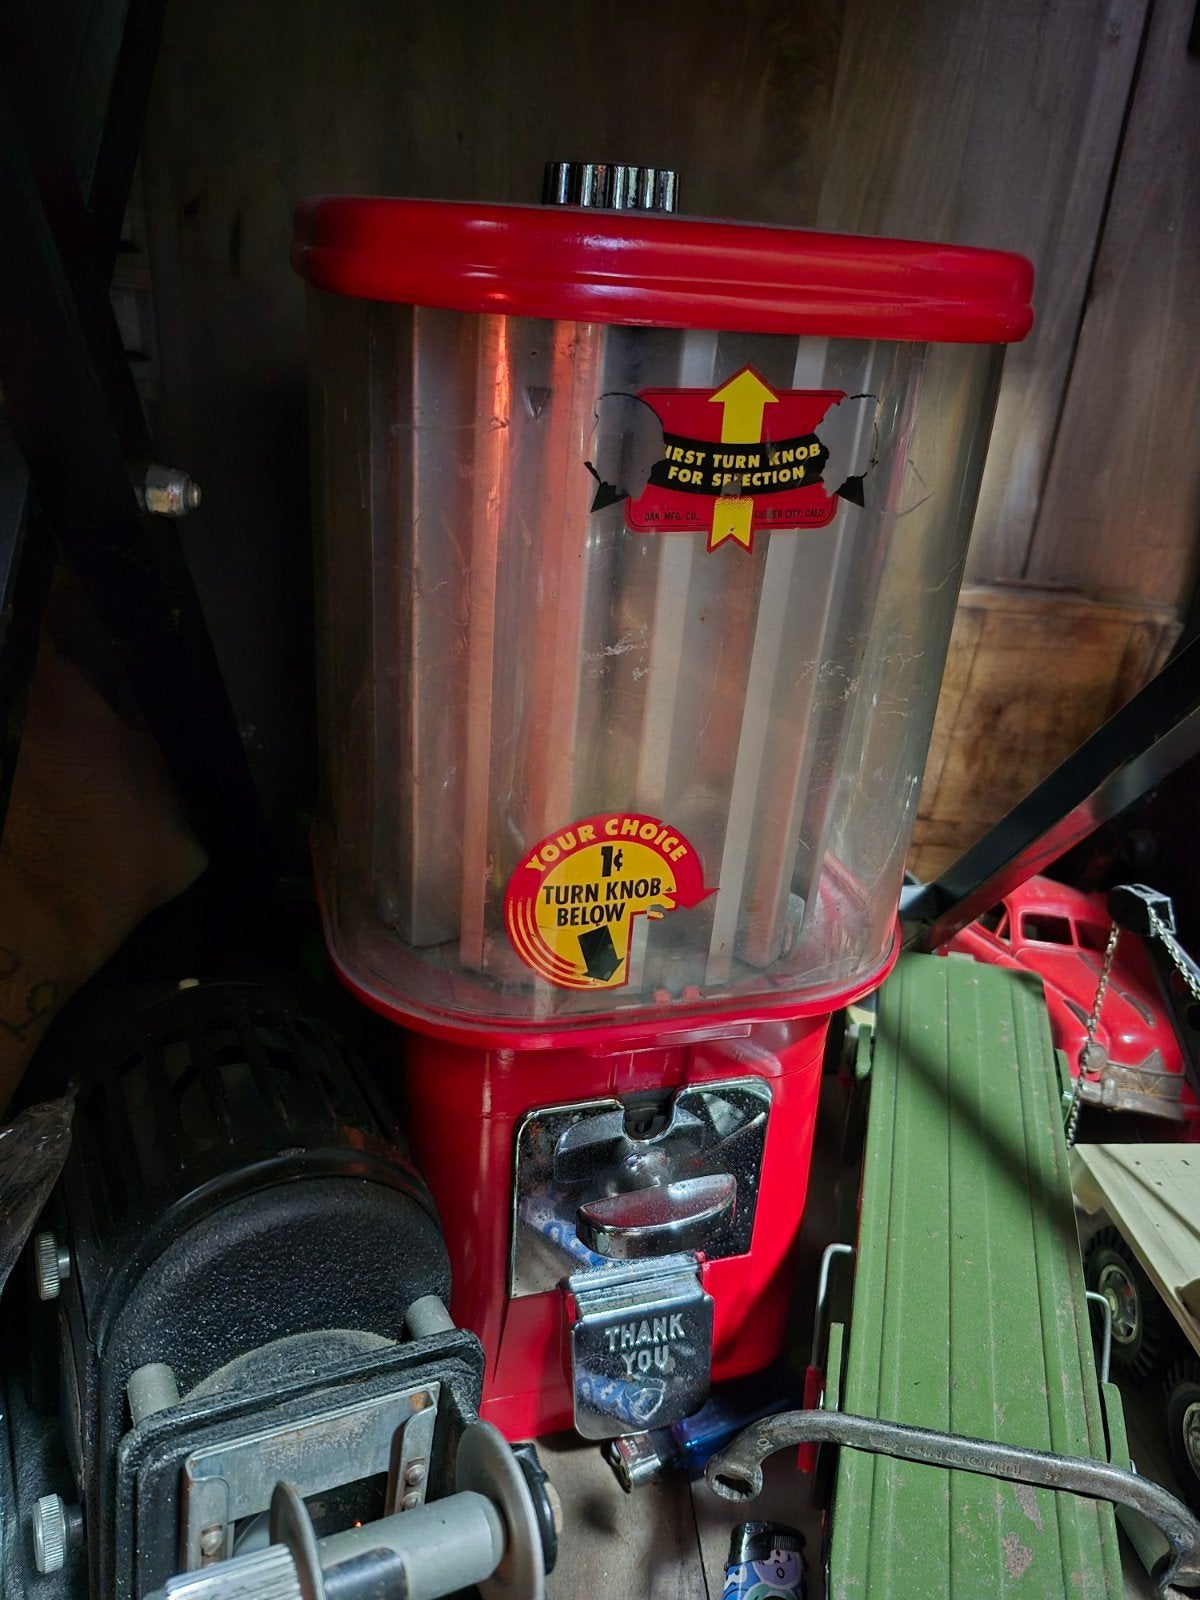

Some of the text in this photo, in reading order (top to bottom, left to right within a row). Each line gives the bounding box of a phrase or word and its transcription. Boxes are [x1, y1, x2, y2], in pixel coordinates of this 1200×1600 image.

[664, 442, 821, 469] IRST TURN KNOB
[667, 464, 806, 488] FOR SEECTION
[525, 818, 688, 872] YOUR CHOICE
[600, 845, 624, 878] 1¢
[542, 877, 662, 905] TURN KNOB
[556, 902, 626, 927] BELOW
[604, 1313, 685, 1352] THANK
[622, 1344, 670, 1375] YOU
